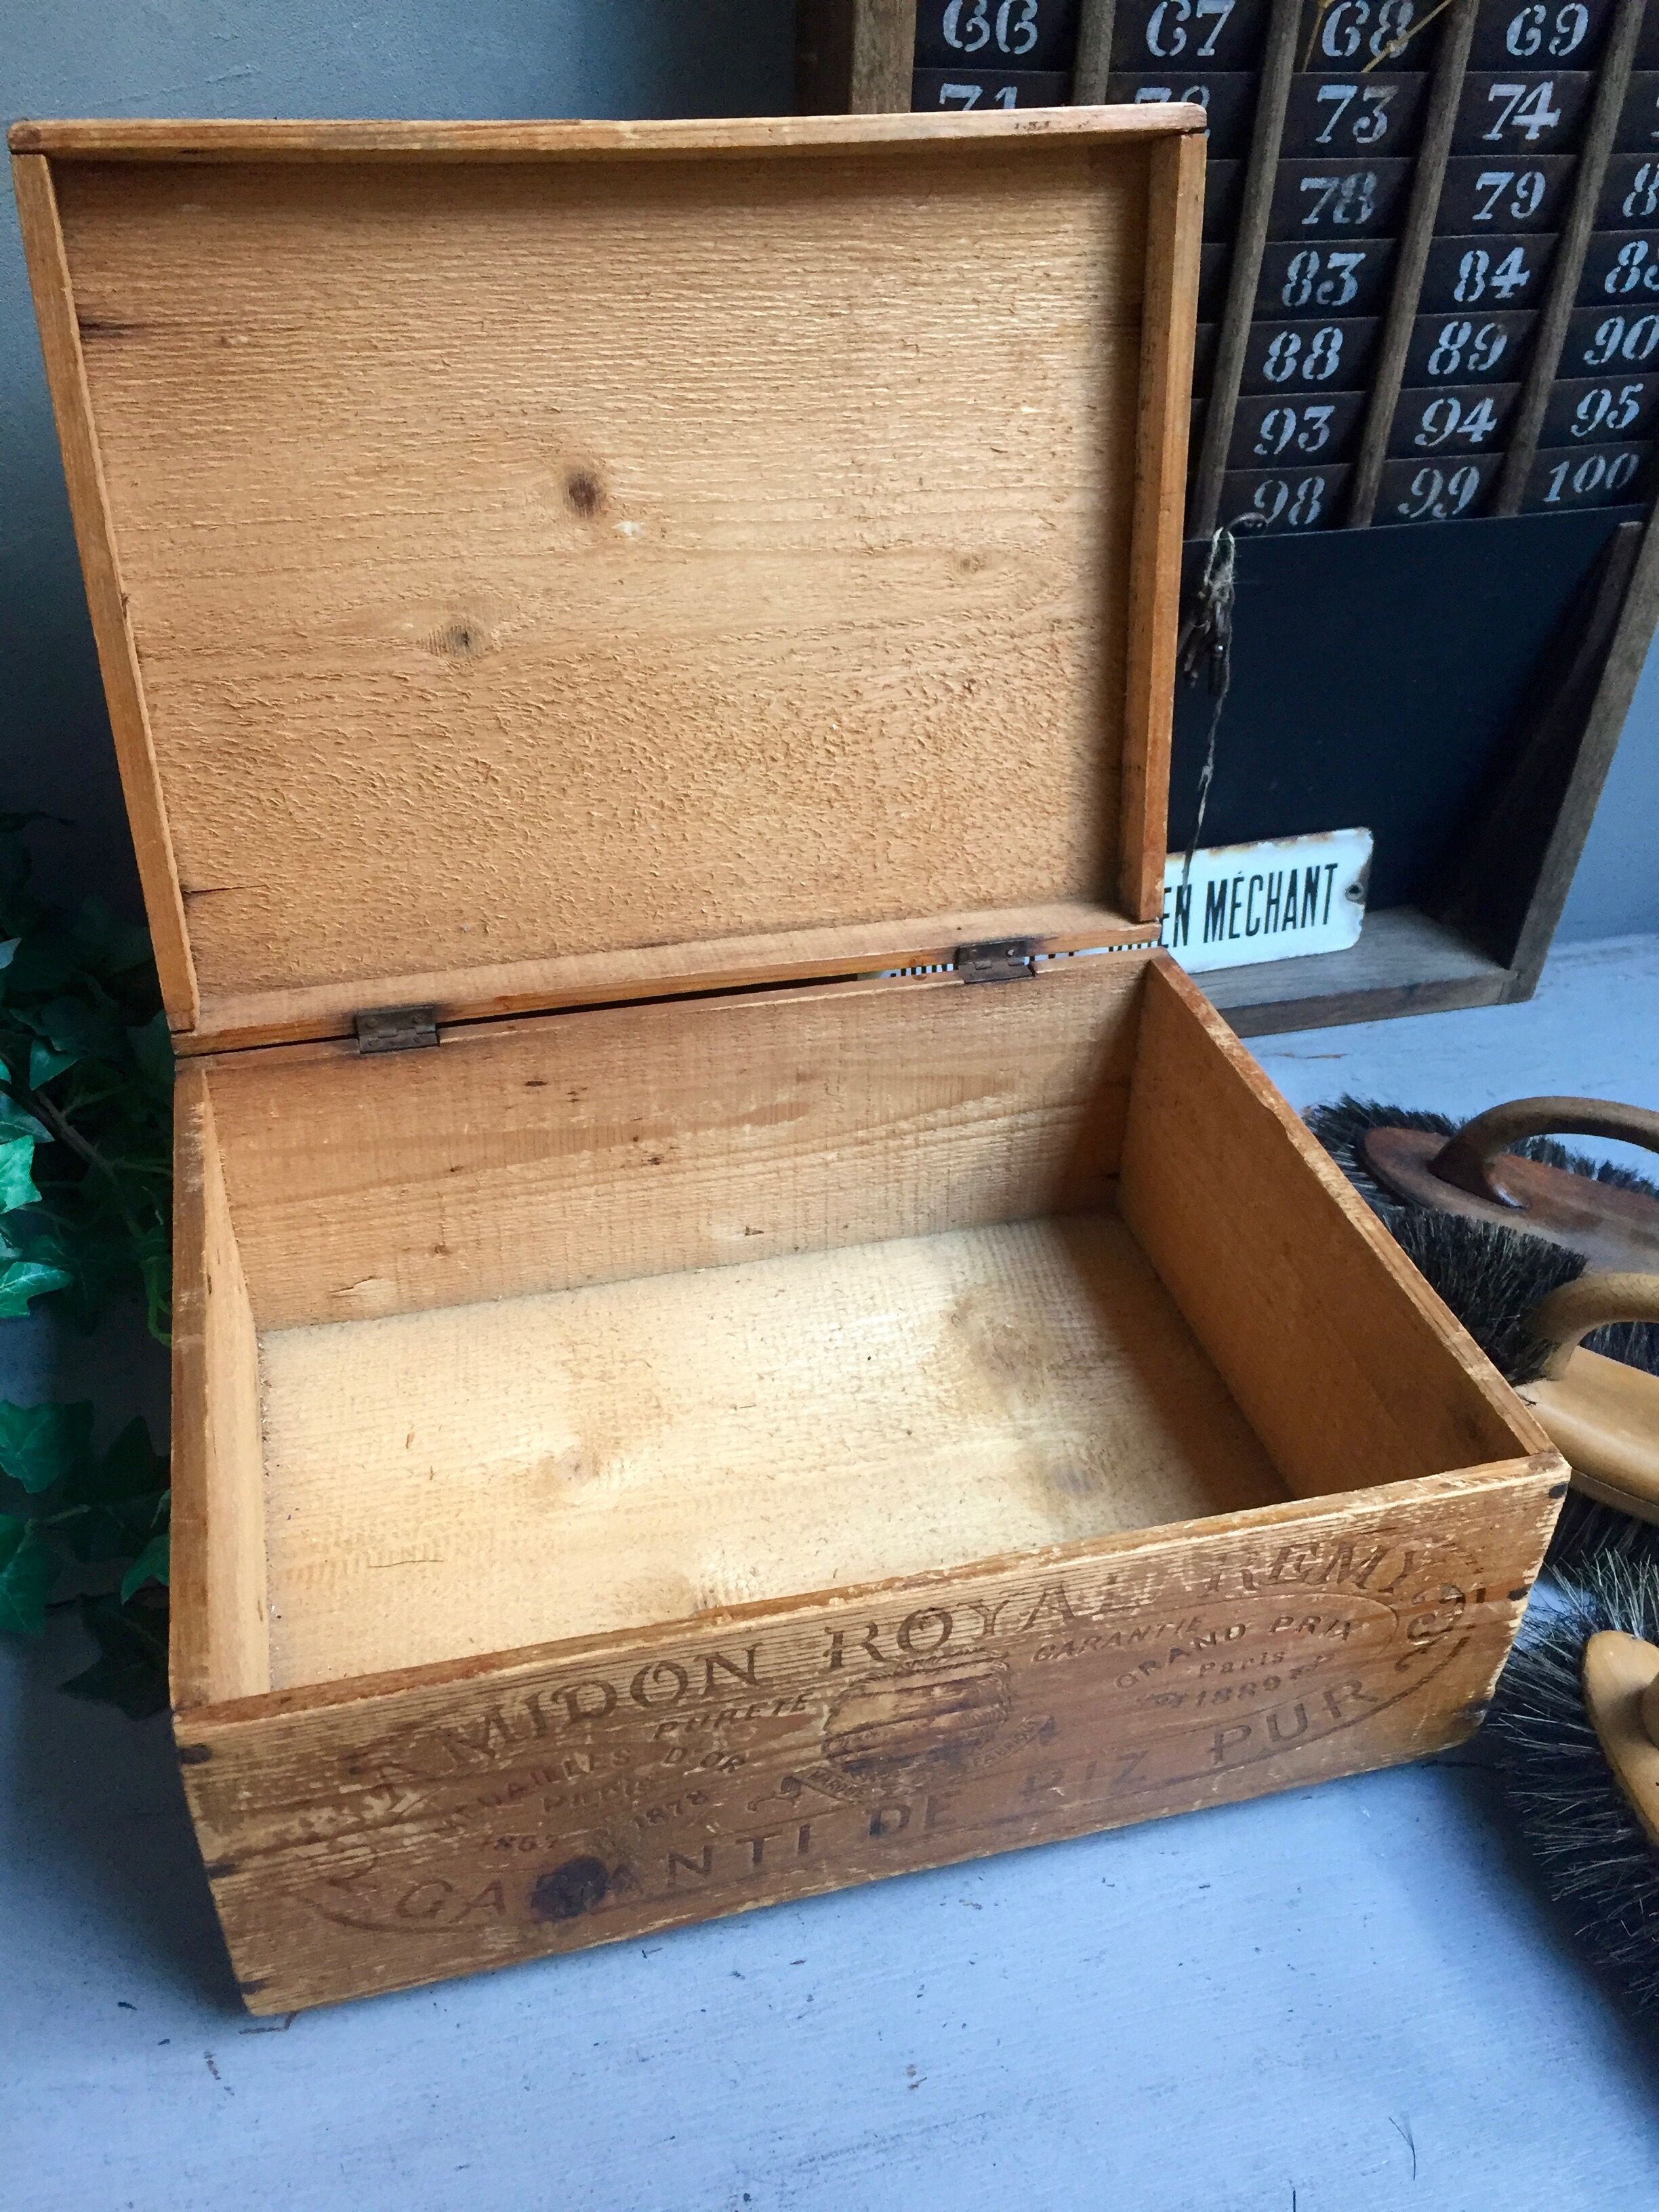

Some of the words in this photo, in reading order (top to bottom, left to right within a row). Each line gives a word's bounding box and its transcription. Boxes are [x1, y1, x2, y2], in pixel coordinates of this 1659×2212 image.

[943, 0, 1038, 55] 66
[1145, 0, 1235, 57] 67
[1322, 0, 1414, 58] 68
[1506, 2, 1590, 56] 69
[1315, 83, 1399, 144] 73
[1482, 80, 1561, 141] 74
[1299, 171, 1378, 226] 78
[1472, 171, 1546, 221] 79
[1282, 250, 1367, 307] 83
[1454, 246, 1531, 303] 84
[1263, 326, 1344, 383] 88
[1427, 321, 1508, 375] 89
[1582, 314, 1659, 366] 90
[1253, 405, 1336, 455] 93
[1414, 396, 1498, 447] 94
[1571, 382, 1645, 438] 95
[1253, 476, 1326, 526] 98
[1398, 466, 1481, 519] 99
[1542, 452, 1641, 504] 100
[1202, 861, 1339, 944] MÉCHANT
[1031, 1616, 1204, 1663] GARANTIE
[1197, 1651, 1286, 1678] Paris
[394, 1822, 812, 1922] GAANTI
[865, 1791, 962, 1836] DE
[1205, 1679, 1378, 1765] PUR
